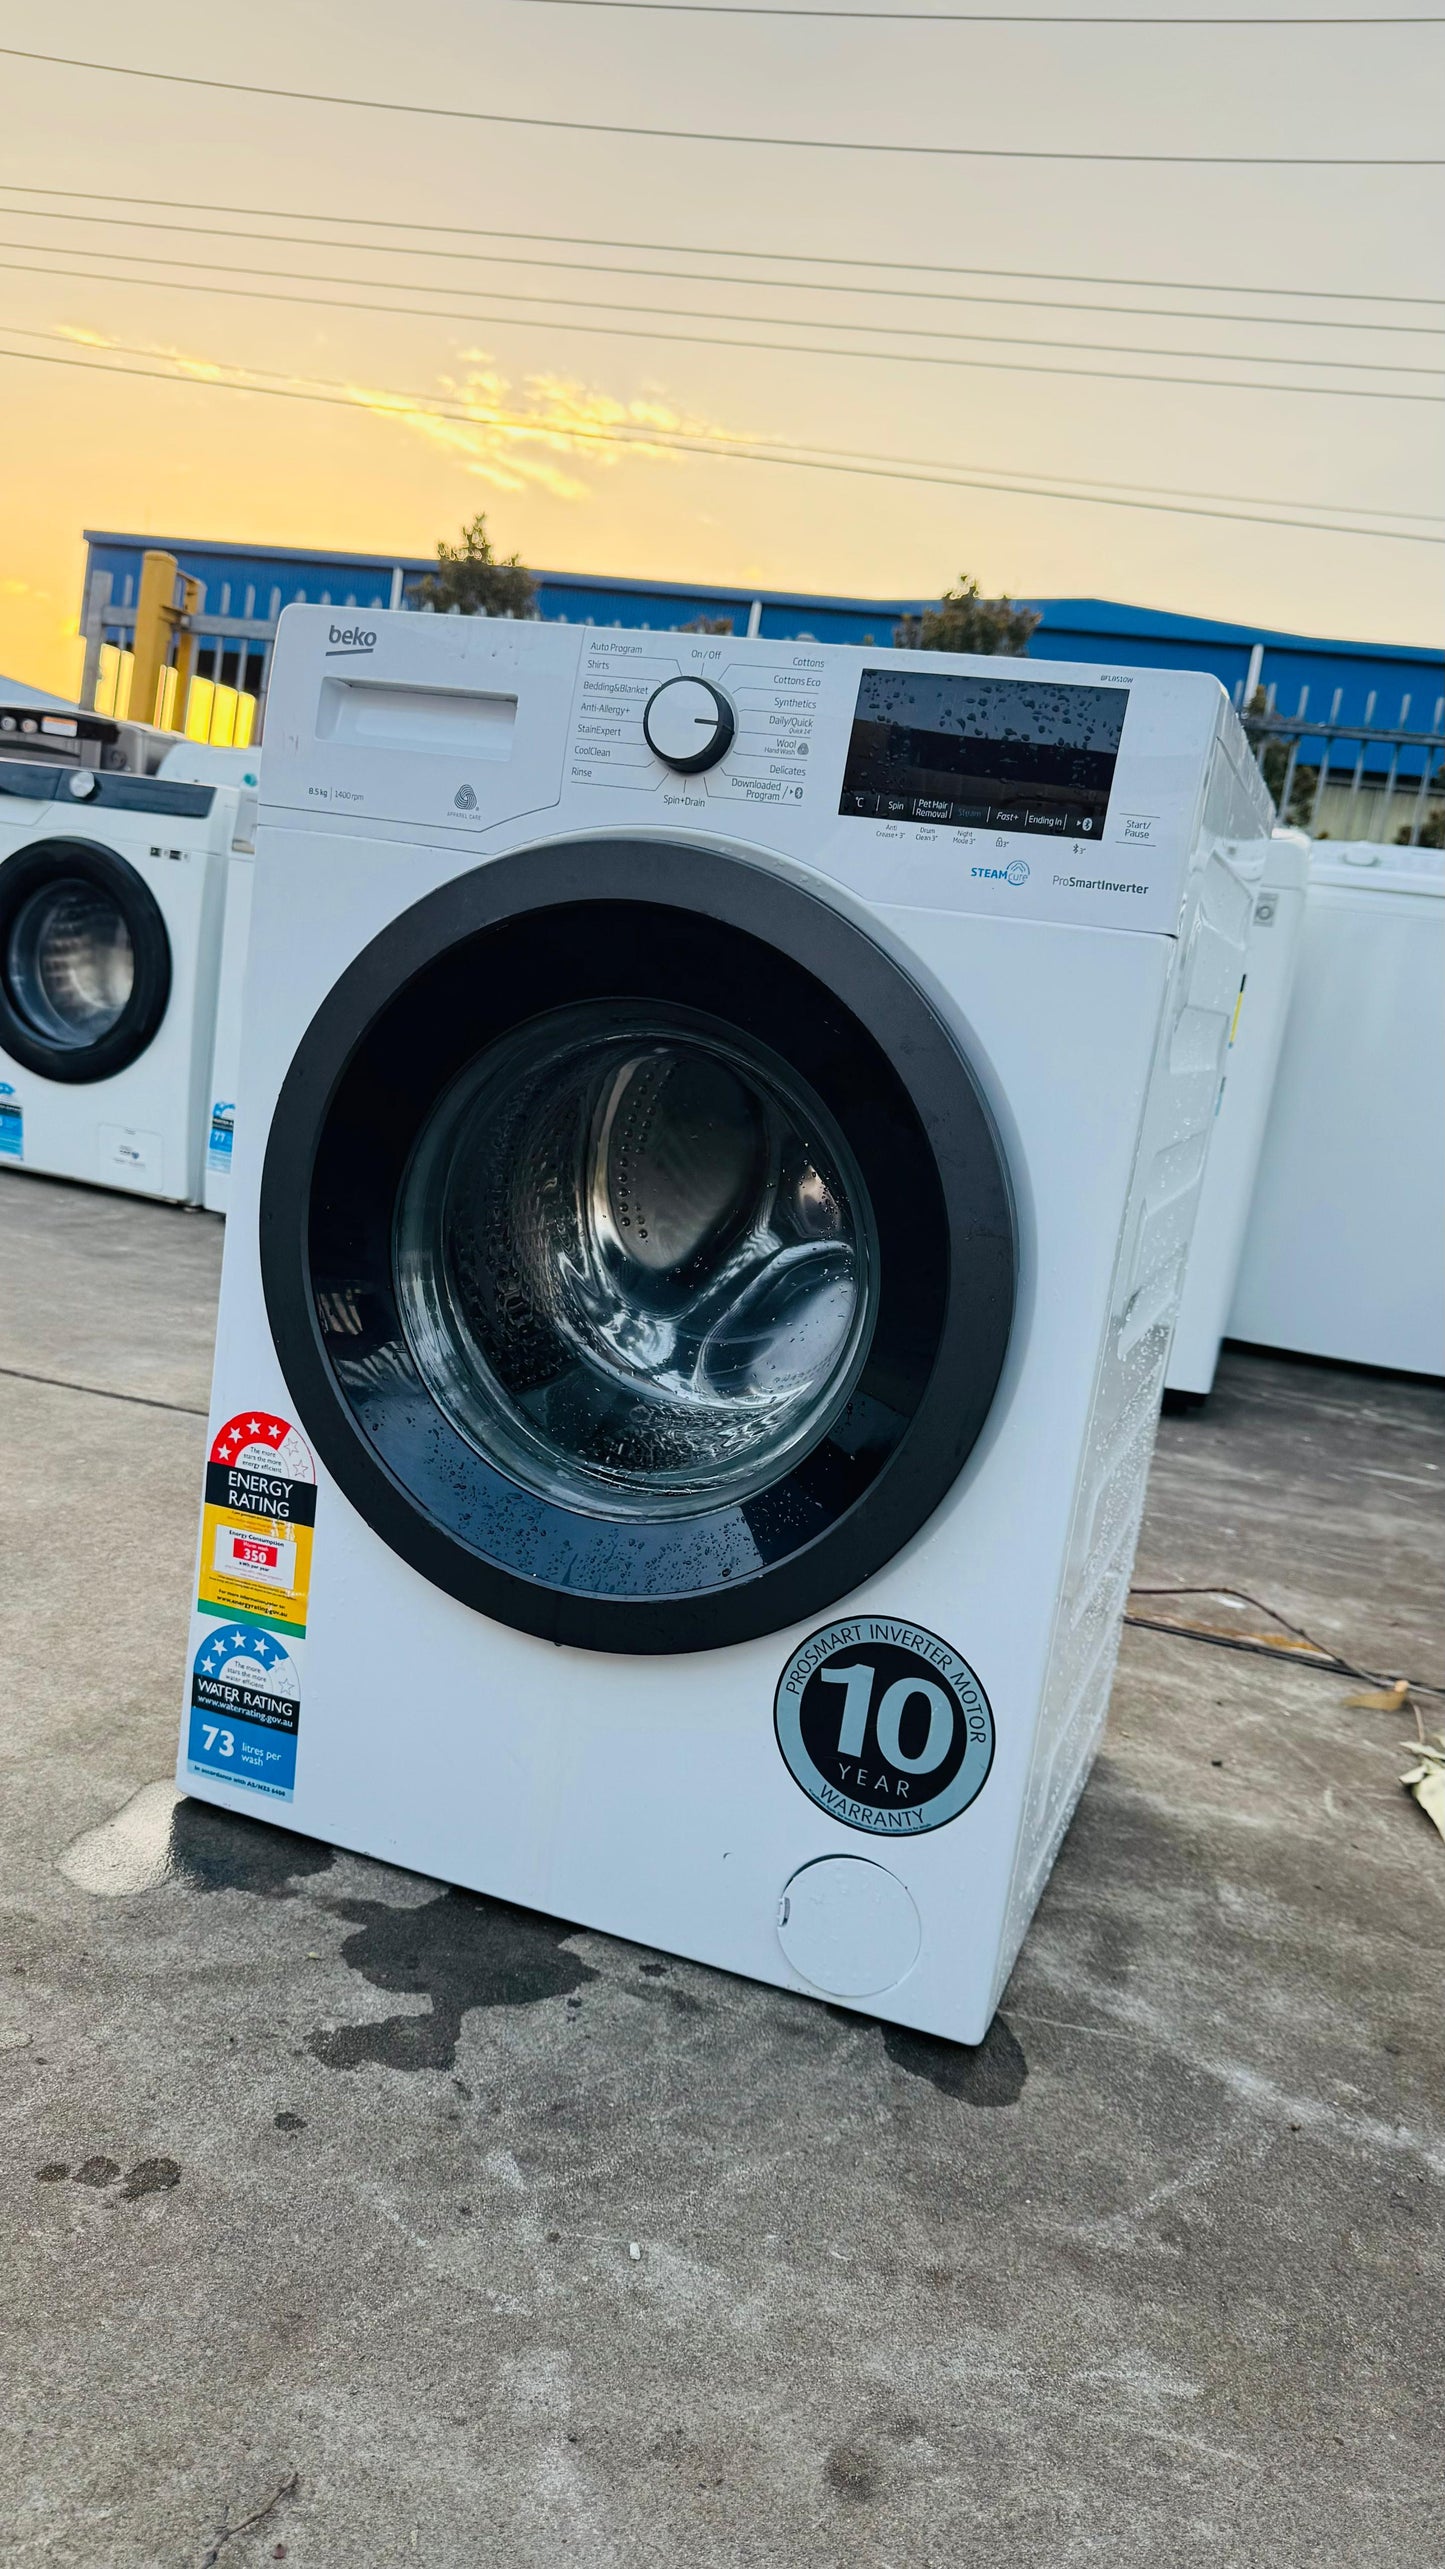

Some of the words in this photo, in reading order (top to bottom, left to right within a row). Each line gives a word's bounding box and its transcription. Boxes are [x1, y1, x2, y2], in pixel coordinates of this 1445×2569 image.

[328, 624, 377, 647] beko
[590, 642, 610, 652] Auto
[610, 643, 643, 655] Program
[691, 650, 703, 659] On
[708, 650, 722, 660] Off
[588, 660, 610, 670] Shirts
[792, 657, 825, 668] Cottons
[774, 674, 806, 686] Cottons
[806, 678, 822, 687] Eco
[584, 681, 649, 695] Bedding&Blanket
[580, 702, 631, 717] Anti-Allergy+
[774, 696, 817, 710] Synthetics
[769, 715, 814, 728] Daily/Quick
[577, 724, 622, 737] StainExpert
[776, 738, 797, 749] Wool
[574, 746, 611, 758] CoolClean
[764, 746, 780, 754] Hand
[780, 748, 796, 756] Wash
[571, 766, 593, 778] Rinse
[770, 764, 807, 777] Delicates
[731, 778, 782, 792] Downloaded
[308, 787, 320, 796] 8.5
[320, 788, 328, 798] kg
[334, 788, 351, 800] 1400
[351, 792, 365, 801] rpm
[746, 789, 780, 801] Program
[664, 794, 706, 808] Spin+Drain
[888, 801, 904, 811] Spin
[918, 798, 932, 808] Pet
[932, 800, 949, 810] Hair
[915, 808, 948, 819] Removal
[958, 808, 982, 817] Steam
[996, 811, 1020, 822] Fast+
[1028, 814, 1054, 827] Ending
[1054, 816, 1063, 826] In
[1126, 819, 1152, 830] Start/
[885, 824, 898, 832] Anti
[920, 826, 936, 835] Drum
[957, 830, 973, 838] Night
[1124, 828, 1150, 840] Pause
[916, 834, 932, 842] Clean
[952, 836, 969, 845] Mode
[1052, 874, 1150, 895] ProSmartInverter
[250, 1446, 261, 1455] The
[261, 1448, 276, 1458] more
[256, 1454, 268, 1463] the
[268, 1458, 282, 1466] more
[242, 1460, 260, 1470] energy
[260, 1463, 283, 1474] efficient
[228, 1470, 294, 1499] ENERGY
[228, 1489, 290, 1518] RATING
[229, 1529, 248, 1540] Energy
[248, 1534, 285, 1548] Consumption
[243, 1548, 268, 1564] 350
[234, 1660, 246, 1670] The
[246, 1664, 262, 1674] more
[227, 1668, 241, 1676] stars
[240, 1670, 252, 1679] the
[252, 1674, 267, 1682] more
[785, 1624, 864, 1696] PROSMART
[869, 1623, 954, 1672] INVERTER
[950, 1671, 987, 1744] MOTOR
[198, 1678, 240, 1703] WATER
[244, 1691, 294, 1717] RATING
[197, 1694, 294, 1728] www.waterrating.gov.au
[820, 1663, 955, 1776] 10
[202, 1724, 236, 1758] 73
[242, 1742, 264, 1757] litres
[266, 1750, 282, 1761] per
[241, 1754, 264, 1767] wash
[838, 1762, 911, 1799] YEAR
[820, 1783, 925, 1828] WARRANTY
